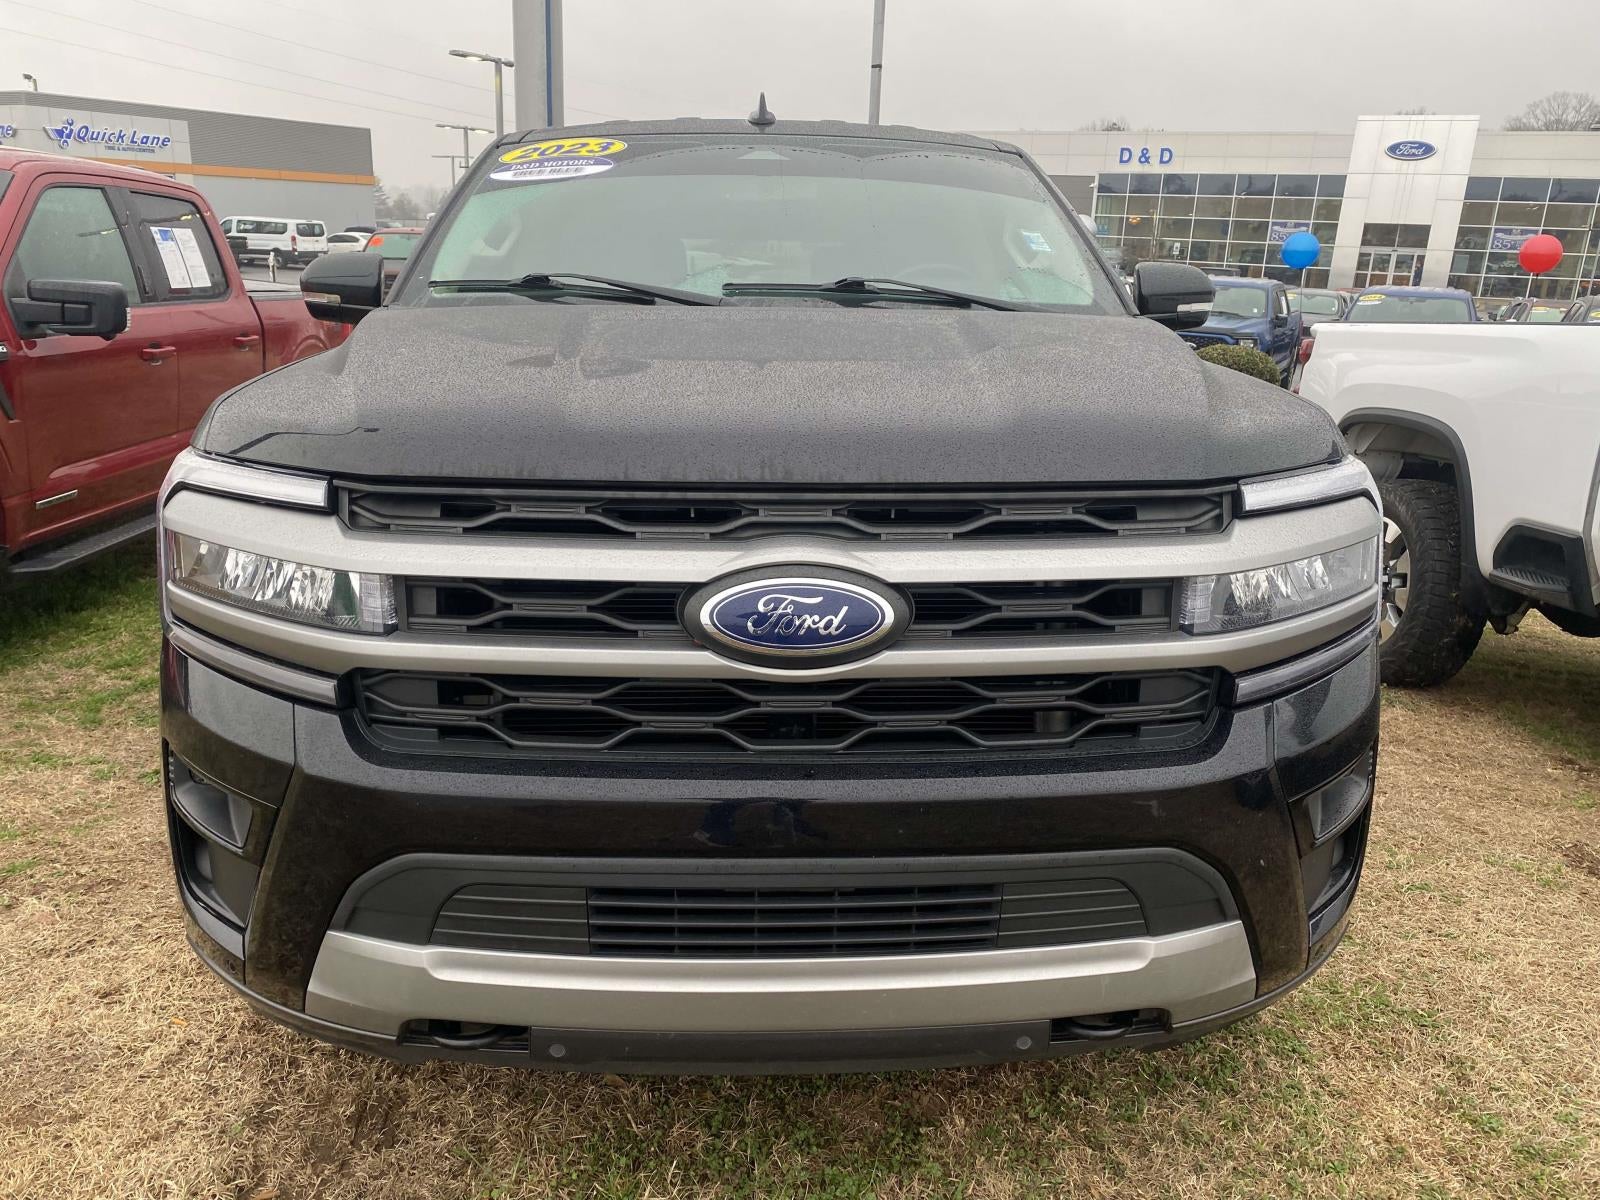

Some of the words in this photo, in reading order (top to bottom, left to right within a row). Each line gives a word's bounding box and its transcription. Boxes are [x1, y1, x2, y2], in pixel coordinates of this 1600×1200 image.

[76, 125, 126, 143] Quick
[130, 130, 171, 148] Lane
[509, 141, 615, 161] 2023
[1119, 147, 1133, 164] D
[1138, 147, 1150, 164] &
[1159, 147, 1173, 164] D
[1396, 143, 1425, 155] Ford
[510, 161, 539, 170] D&D
[541, 159, 595, 168] MOTORS
[747, 593, 848, 636] Ford
